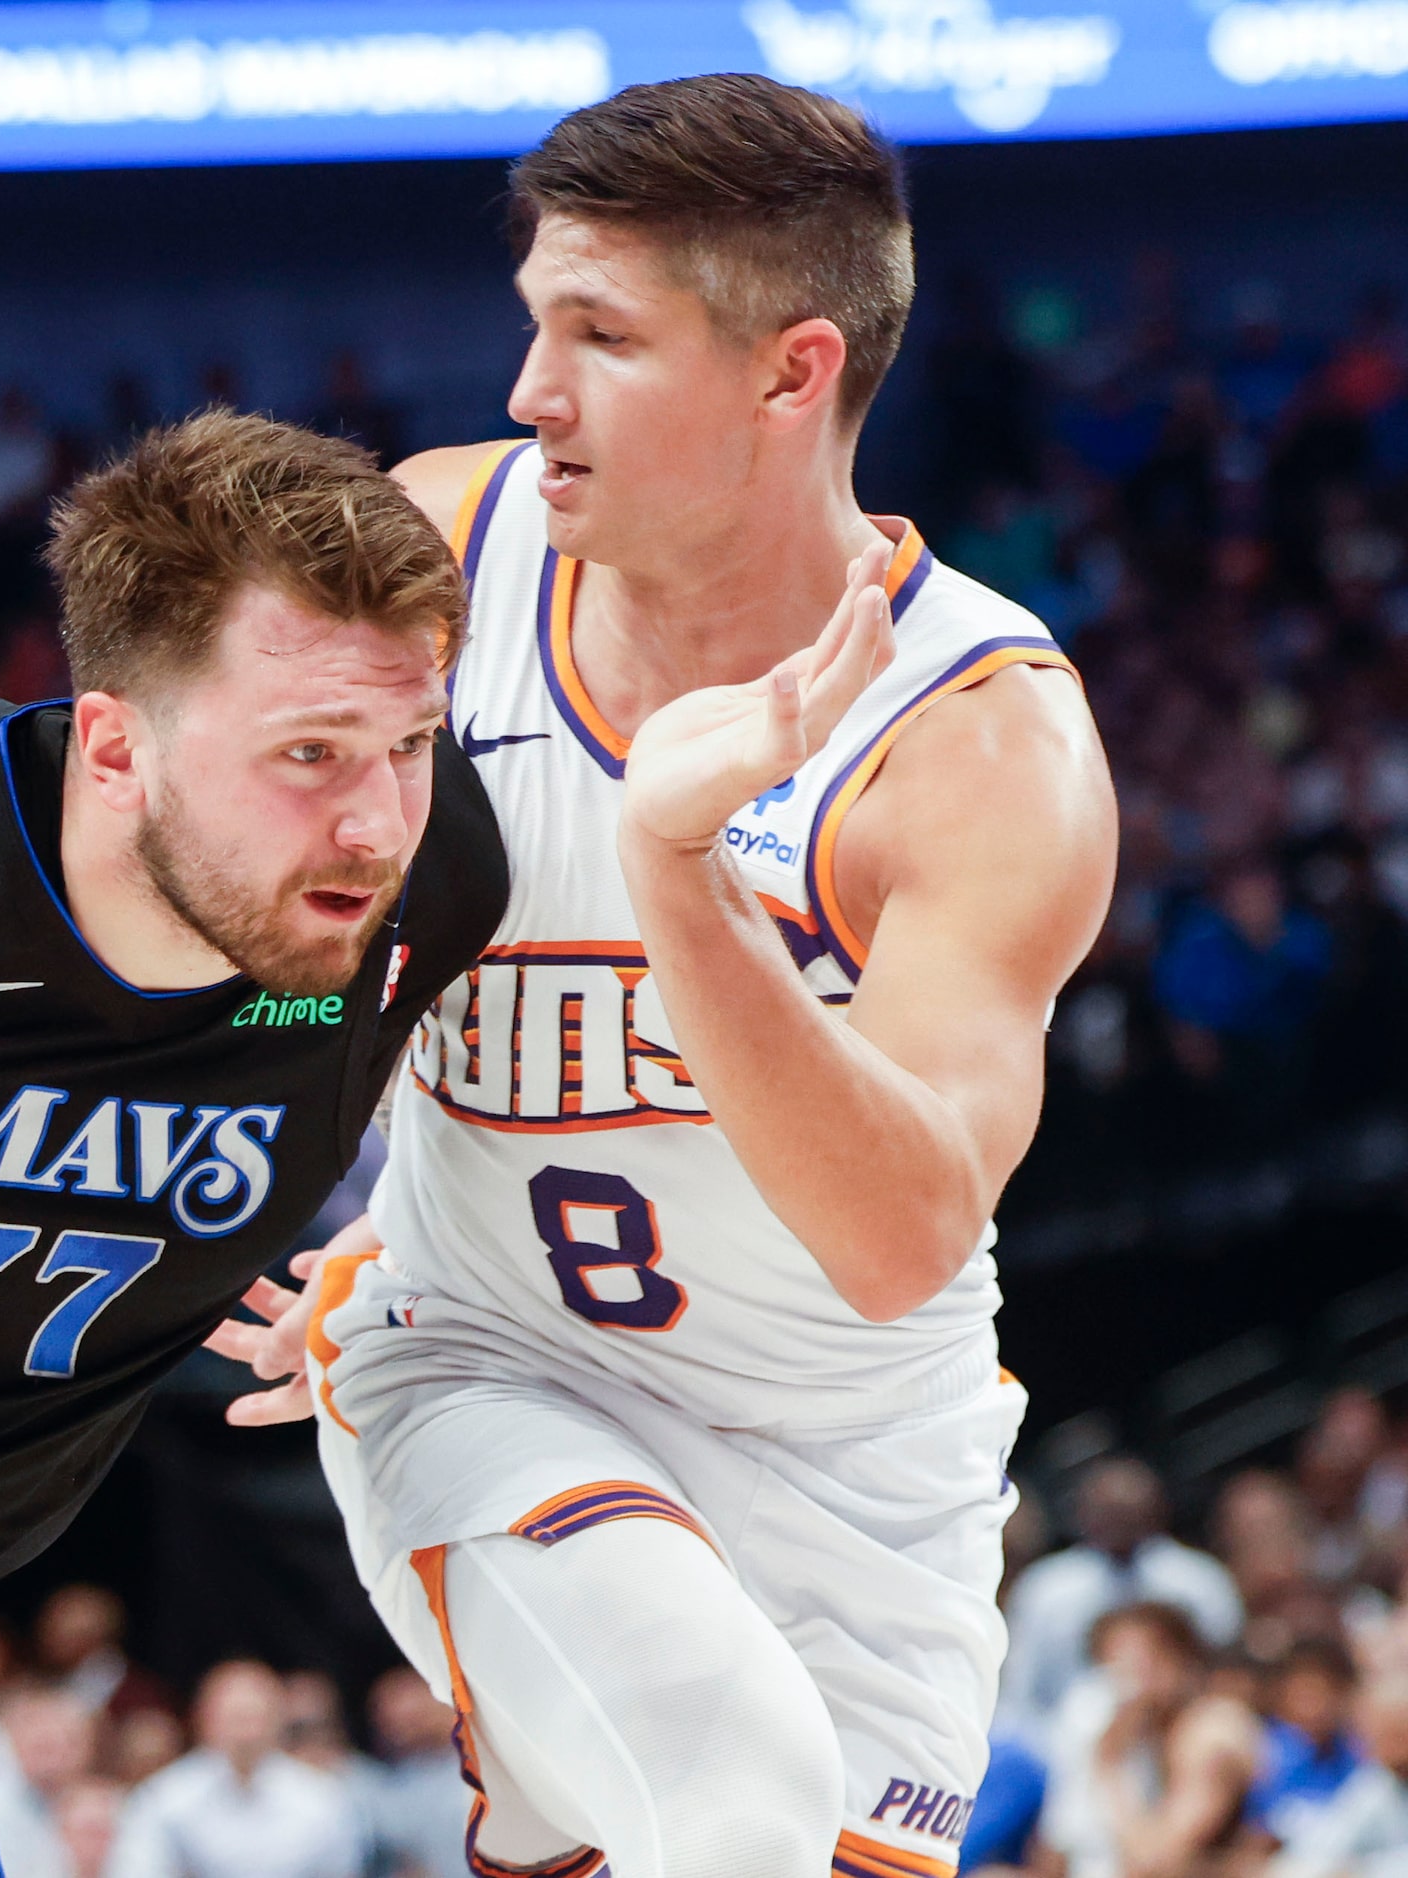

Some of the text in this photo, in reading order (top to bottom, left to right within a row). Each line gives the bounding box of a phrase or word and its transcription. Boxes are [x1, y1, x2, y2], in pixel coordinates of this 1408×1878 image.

[725, 826, 801, 868] ayPal
[232, 990, 344, 1028] chime
[528, 1165, 689, 1332] 8
